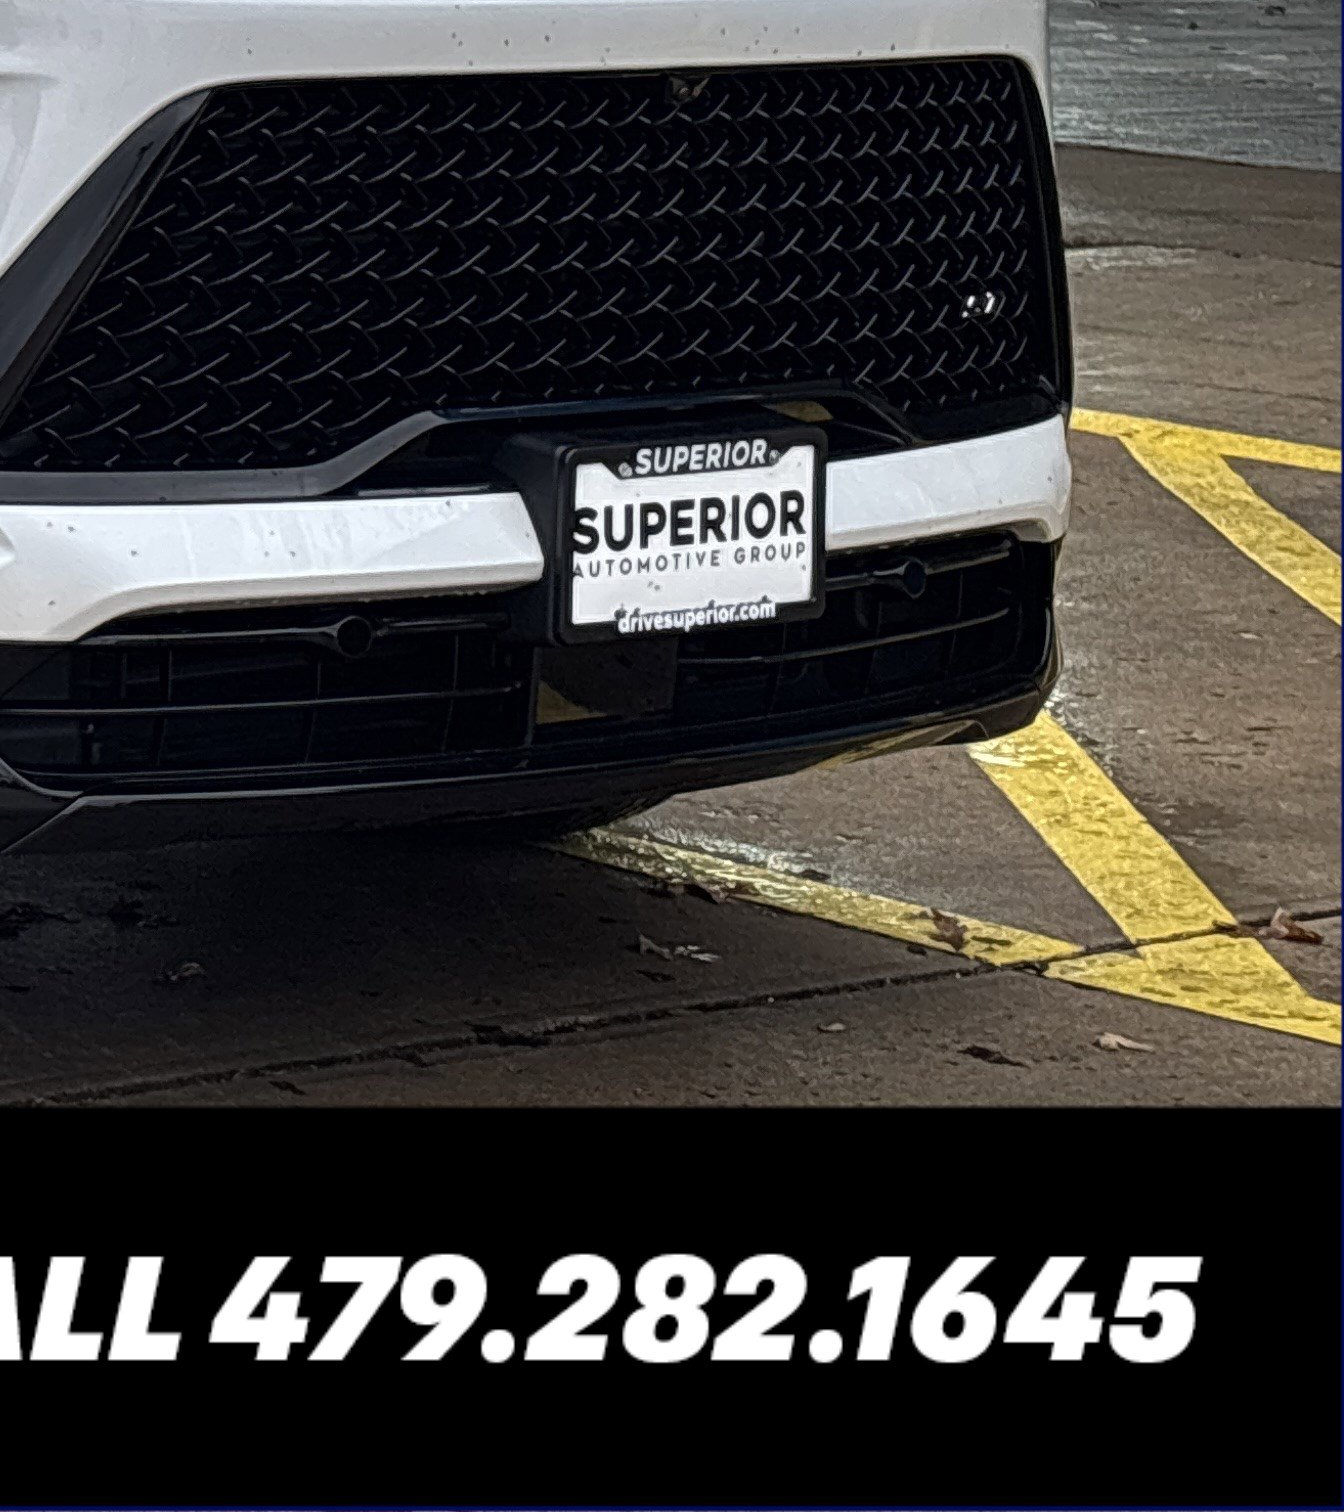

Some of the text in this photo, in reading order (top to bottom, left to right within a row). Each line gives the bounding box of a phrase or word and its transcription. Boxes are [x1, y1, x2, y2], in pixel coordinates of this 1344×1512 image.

[634, 438, 768, 476] SUPERIOR
[569, 489, 808, 555] SUPERIOR
[572, 541, 808, 579] AUTOMOTIVE GROUP
[616, 600, 777, 635] drivesuperior.com
